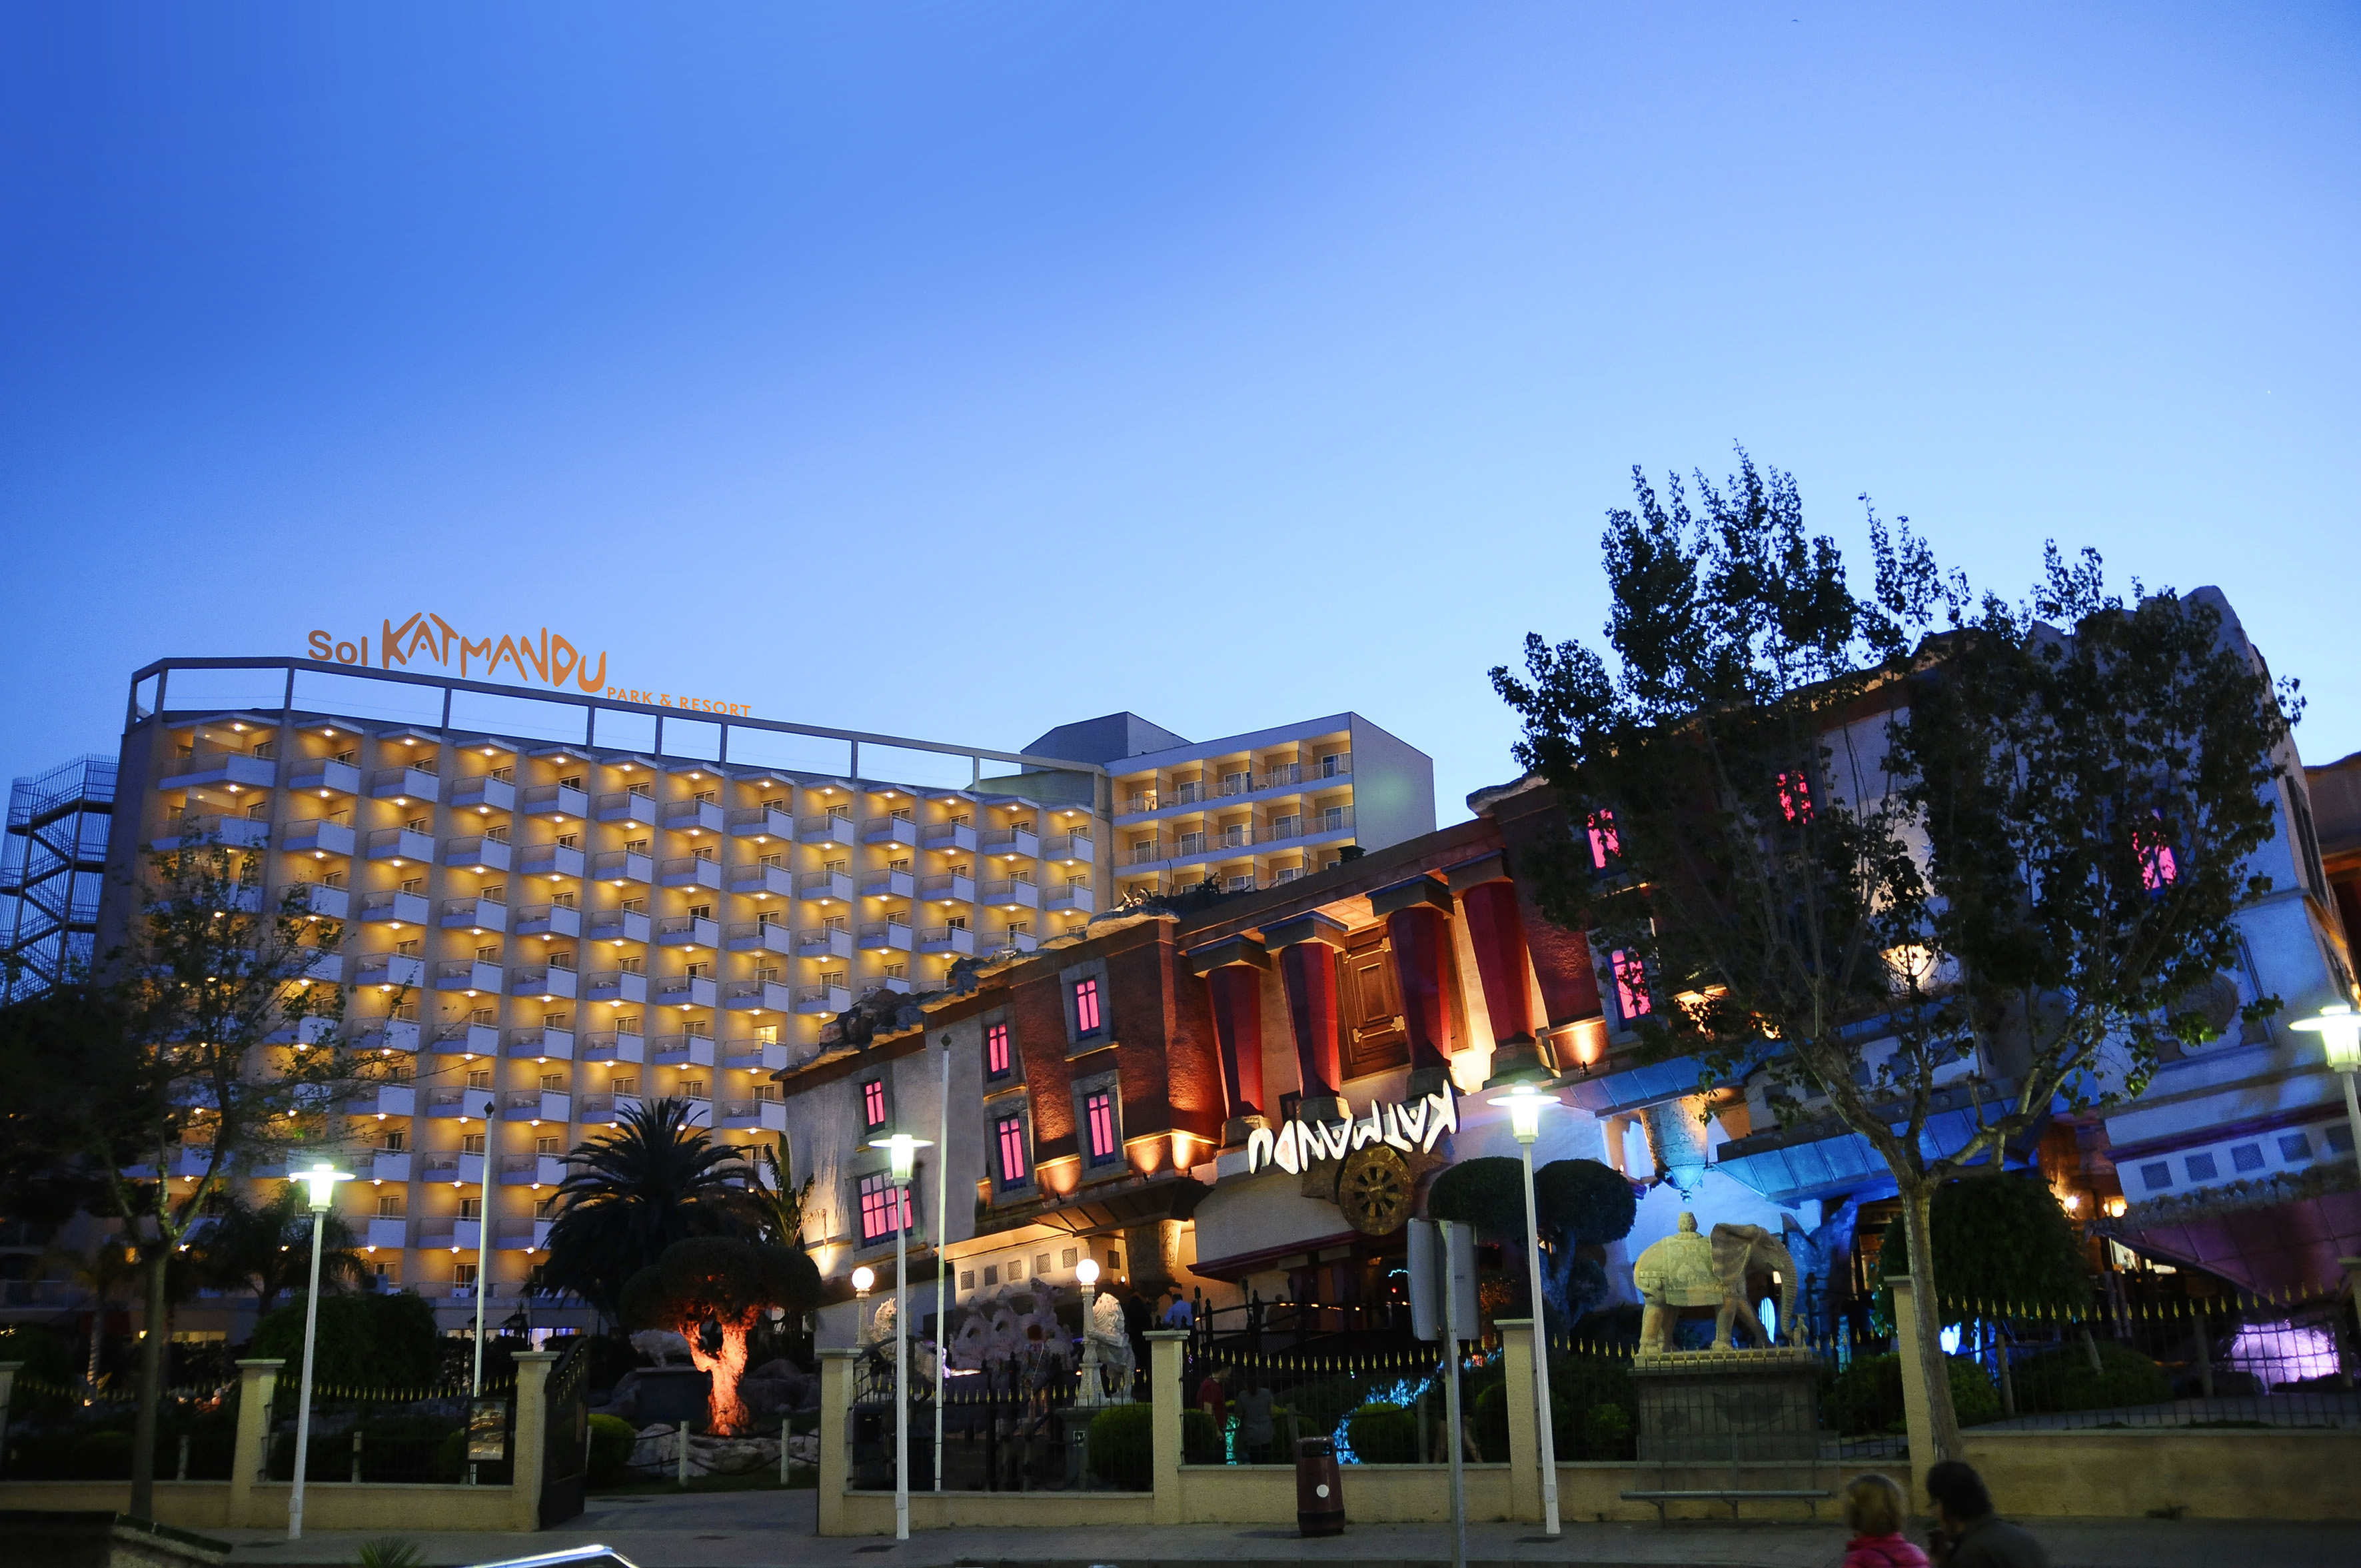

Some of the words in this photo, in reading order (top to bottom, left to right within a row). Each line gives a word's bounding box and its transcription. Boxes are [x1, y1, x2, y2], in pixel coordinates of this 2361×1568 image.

[308, 630, 368, 666] Sol
[382, 612, 606, 693] KATMANDU
[607, 686, 653, 705] PARK
[660, 694, 672, 708] &
[680, 696, 752, 718] RESORT
[1247, 1079, 1461, 1175] KATMANDU
